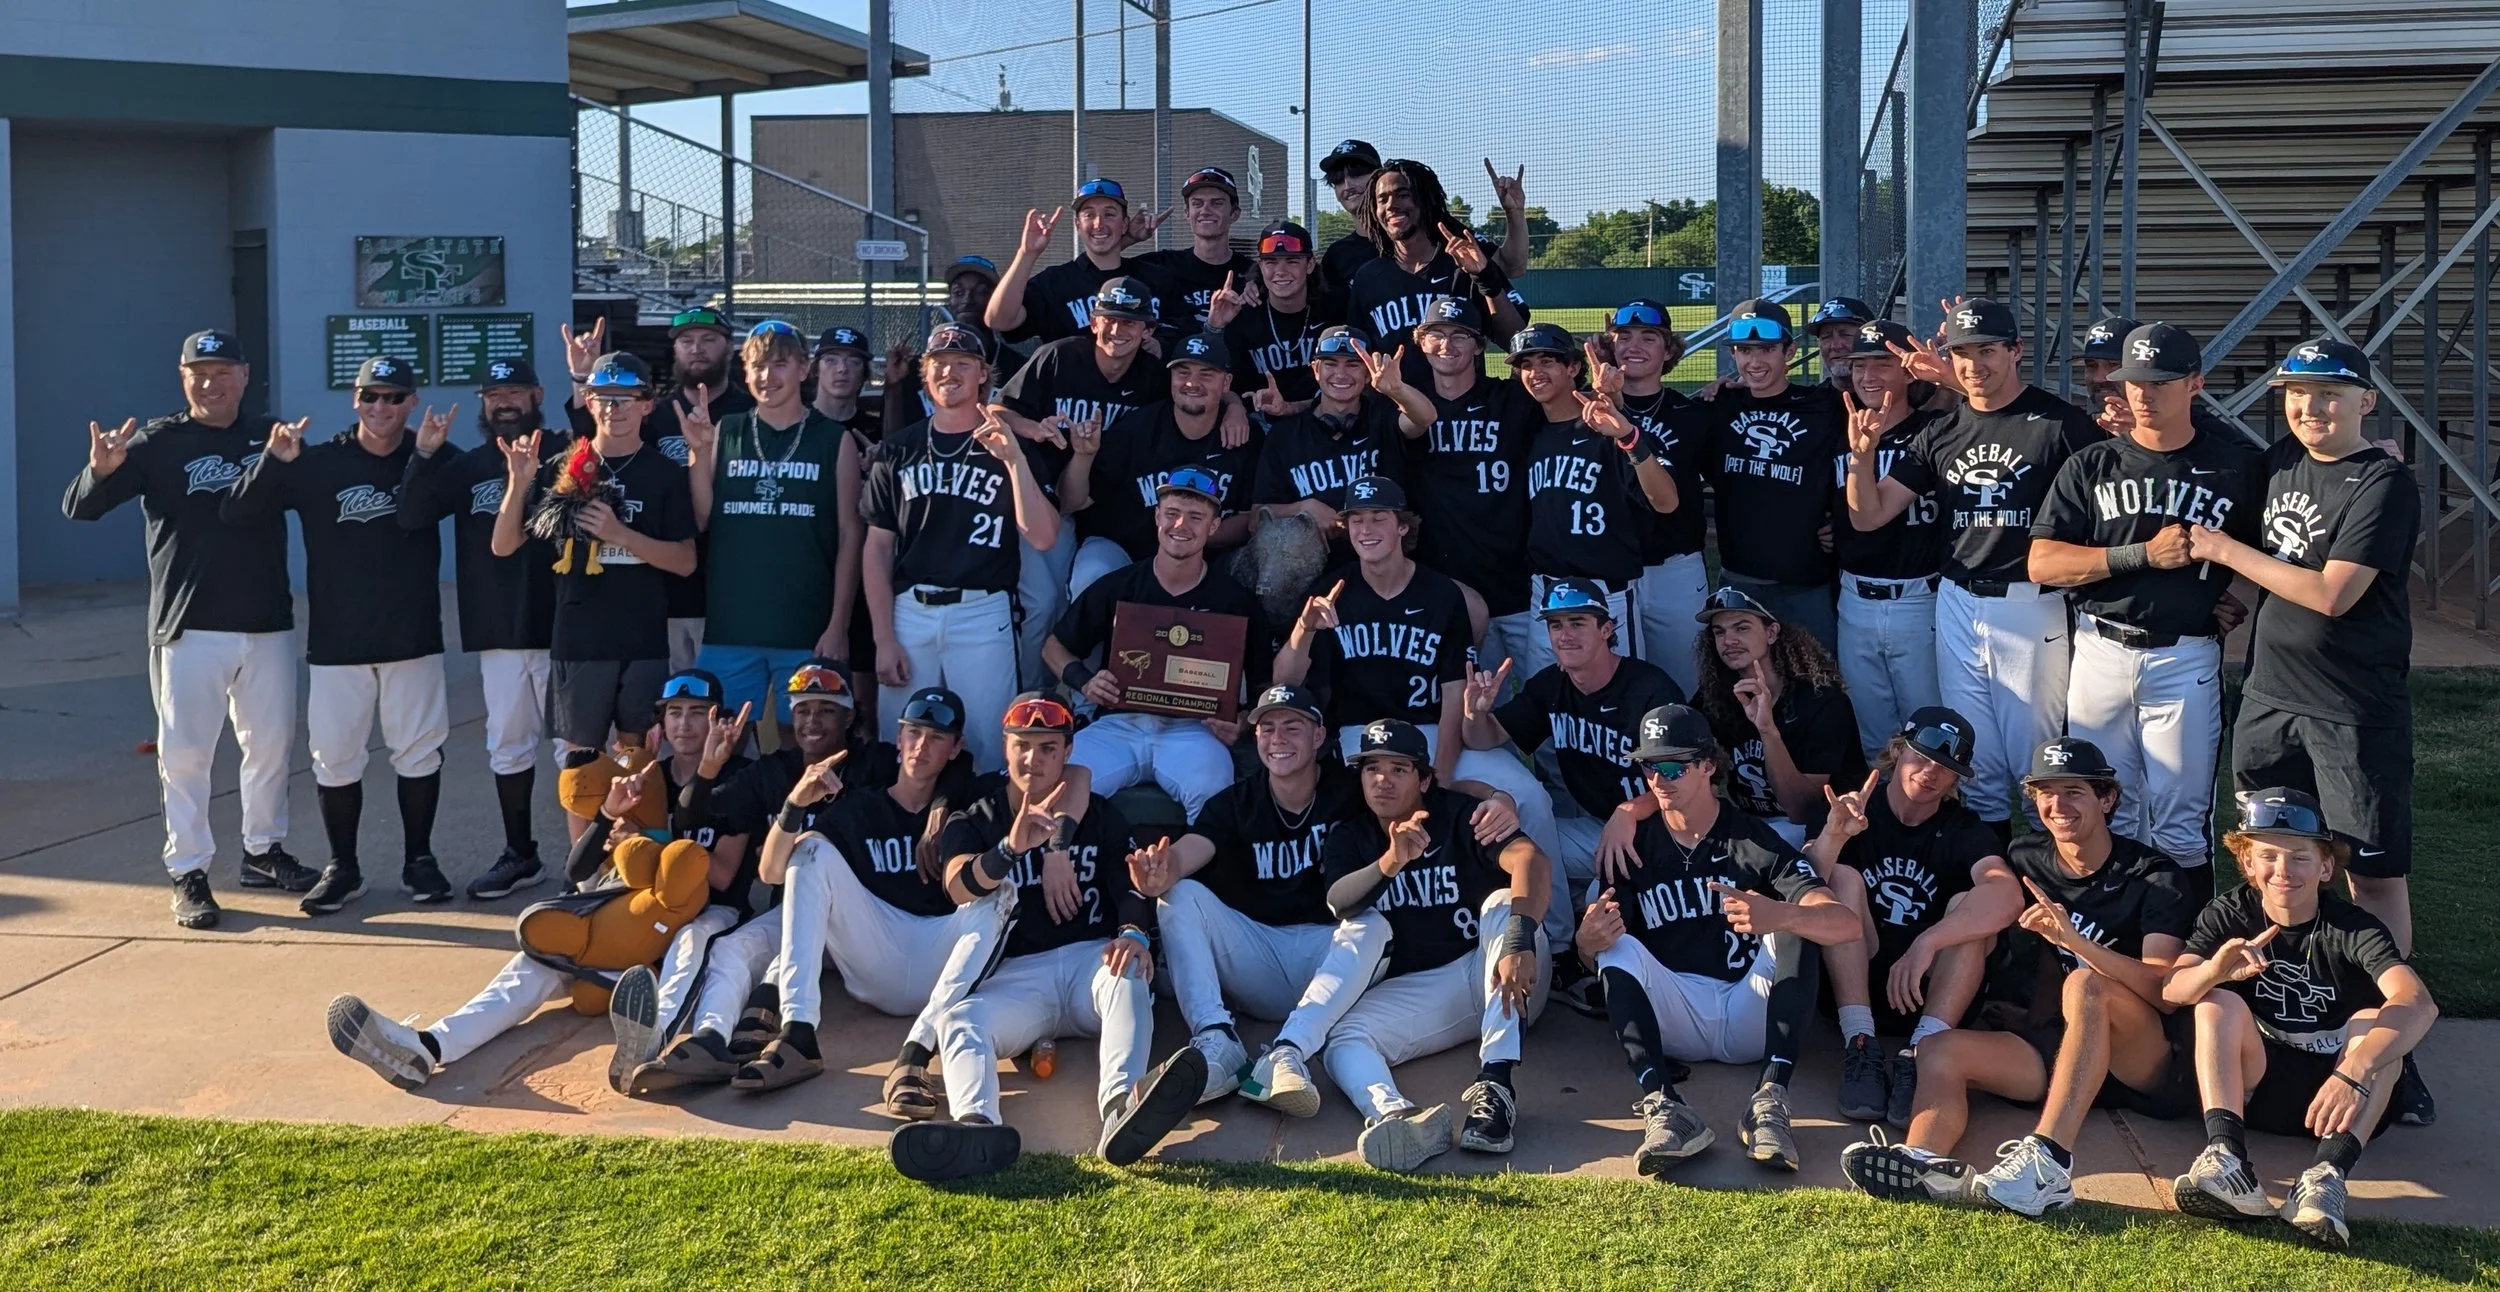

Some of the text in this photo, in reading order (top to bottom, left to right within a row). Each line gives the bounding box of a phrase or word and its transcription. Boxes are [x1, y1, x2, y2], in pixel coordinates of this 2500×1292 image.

[425, 238, 501, 255] STATE
[862, 245, 872, 255] NO
[400, 250, 463, 294] SF
[1678, 272, 1715, 299] SF
[348, 318, 409, 332] BASEBALL
[1369, 293, 1467, 338] WOLV
[1438, 301, 1462, 318] SF
[1956, 308, 1982, 330] SF
[197, 335, 223, 353] SF
[834, 329, 858, 344] SF
[1187, 338, 1209, 355] SF
[1860, 326, 1884, 343] SF
[2089, 325, 2114, 345] SF
[2131, 339, 2160, 361] SF
[371, 361, 396, 377] SF
[490, 362, 514, 380] SF
[1249, 337, 1314, 374] WOLV
[1055, 397, 1140, 431] WOLV
[1730, 410, 1808, 442] BASEBALL
[1428, 419, 1500, 453] LVES
[1641, 416, 1680, 451] BALL
[1744, 425, 1790, 460] SF
[727, 459, 820, 482] CHAMPION
[1476, 460, 1510, 493] 19
[1749, 459, 1766, 477] THE
[1946, 443, 2031, 485] BASEBALL
[897, 461, 1004, 506] WOLVES
[1354, 482, 1378, 499] SF
[1963, 468, 2013, 508] SF
[723, 501, 816, 517] SUMMER PRIDE
[1570, 500, 1606, 535] 13
[1906, 490, 1939, 526] 15
[1973, 510, 1993, 527] THE
[2094, 477, 2234, 533] WOLVES
[2262, 491, 2326, 543] BASEBALL
[968, 512, 1004, 548] 21
[2266, 516, 2308, 562] SF
[600, 547, 638, 557] EBAL
[1335, 622, 1441, 666] WOLVES
[1125, 691, 1218, 710] REGIONAL CHAMPION
[1268, 686, 1295, 703] SF
[1367, 725, 1392, 744] SF
[1548, 712, 1634, 768] WOLVES
[1644, 717, 1668, 740] SF
[1733, 739, 1765, 765] ASEB
[2043, 744, 2073, 766] SF
[1620, 776, 1647, 800] 11
[865, 836, 918, 874] WOL
[1006, 845, 1098, 889] OLES
[1862, 856, 1938, 902] BASEBALL
[1083, 887, 1103, 925] 2
[1637, 875, 1737, 929] WOLV
[1875, 881, 1926, 926] SF
[1453, 907, 1479, 940] 8
[2070, 911, 2119, 949] BALL
[2255, 959, 2336, 1023] SF
[2294, 1035, 2343, 1053] EBALL
